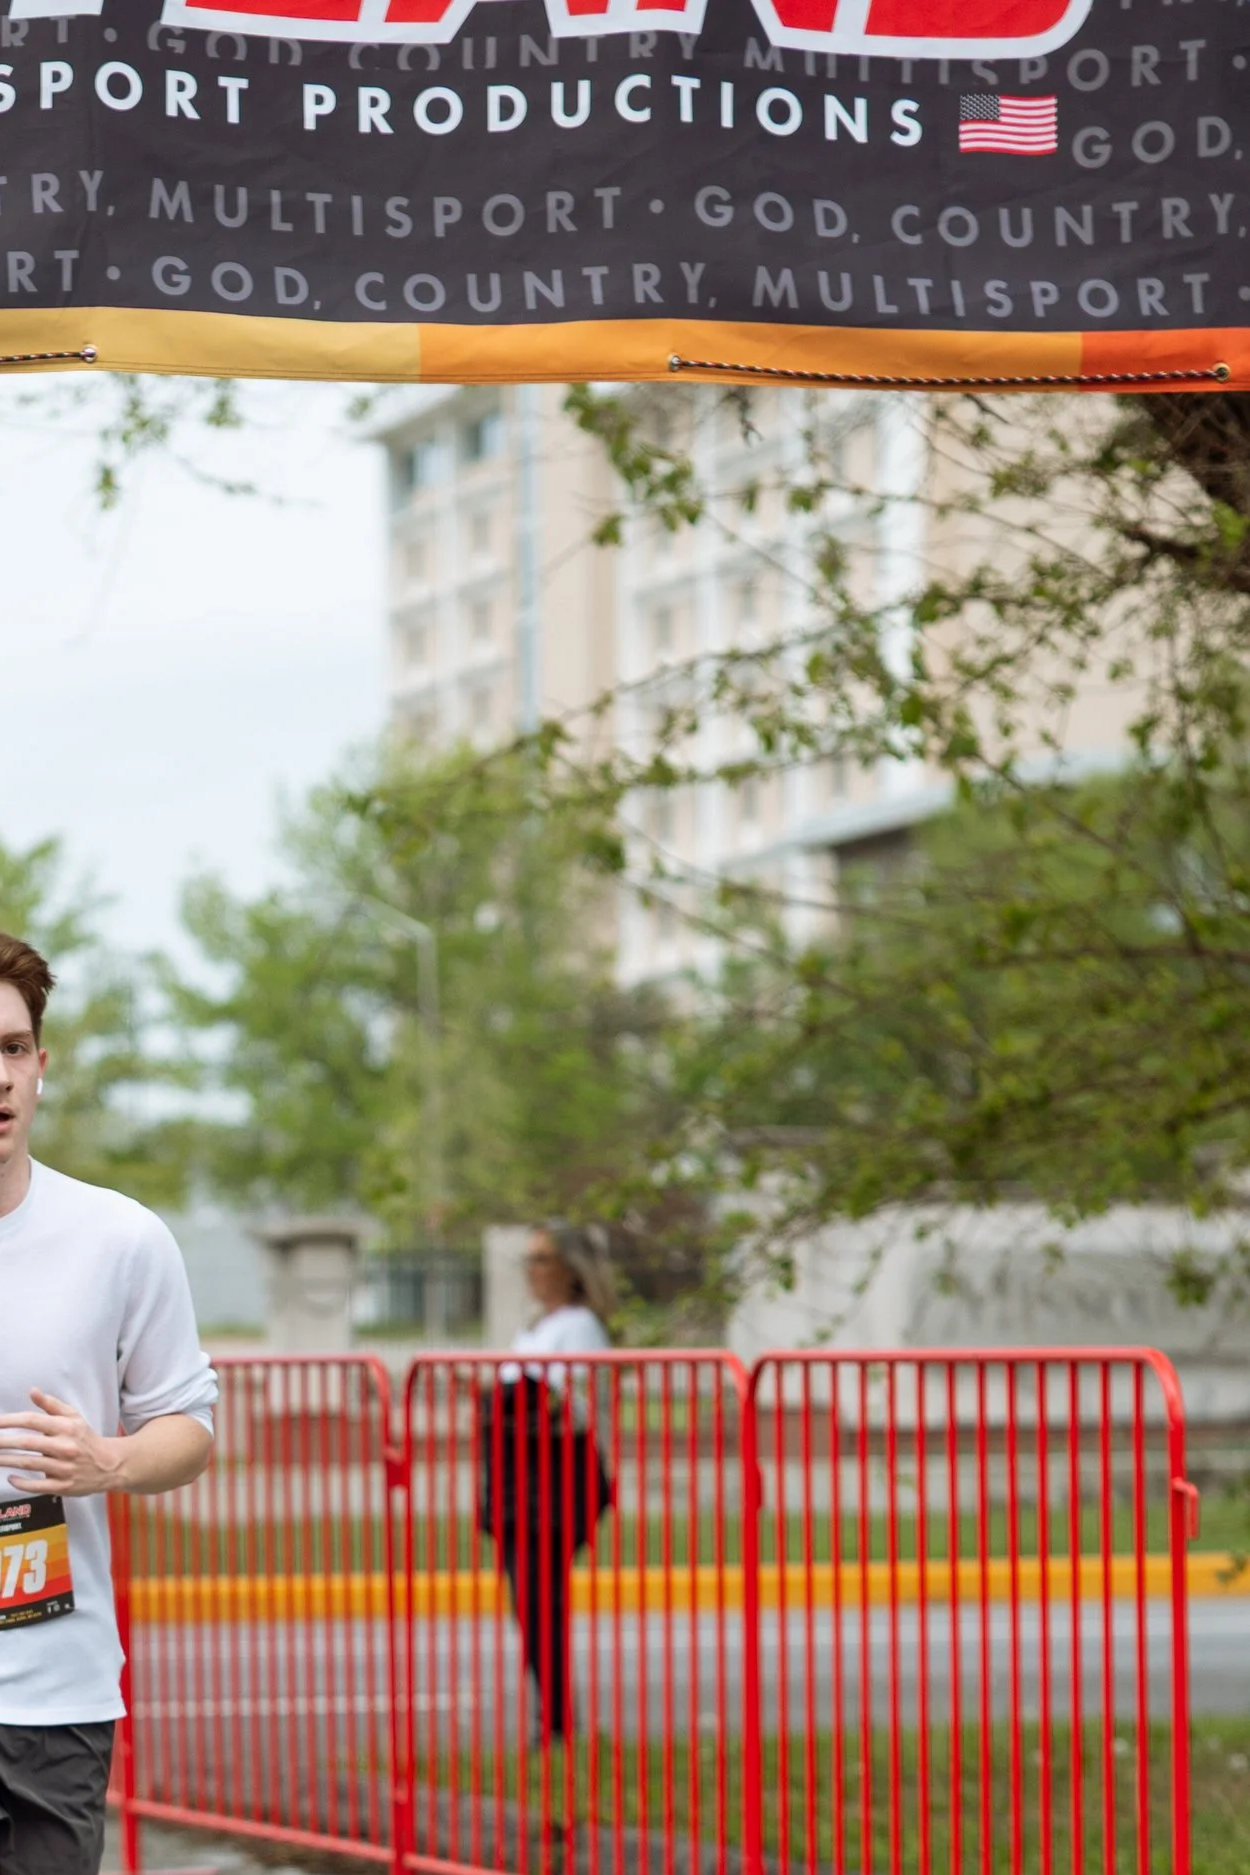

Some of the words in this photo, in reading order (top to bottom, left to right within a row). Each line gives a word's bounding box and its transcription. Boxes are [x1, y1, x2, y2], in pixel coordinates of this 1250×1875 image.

[303, 74, 922, 147] PRODUCTIONS
[1071, 116, 1242, 169] GOD,
[149, 177, 621, 238] MULTISPORT
[694, 185, 859, 244] GOD,
[891, 193, 1247, 248] COUNTRY,
[151, 255, 321, 312] GOD,
[355, 262, 717, 313] COUNTRY,
[754, 265, 1209, 318] MULTISPORT
